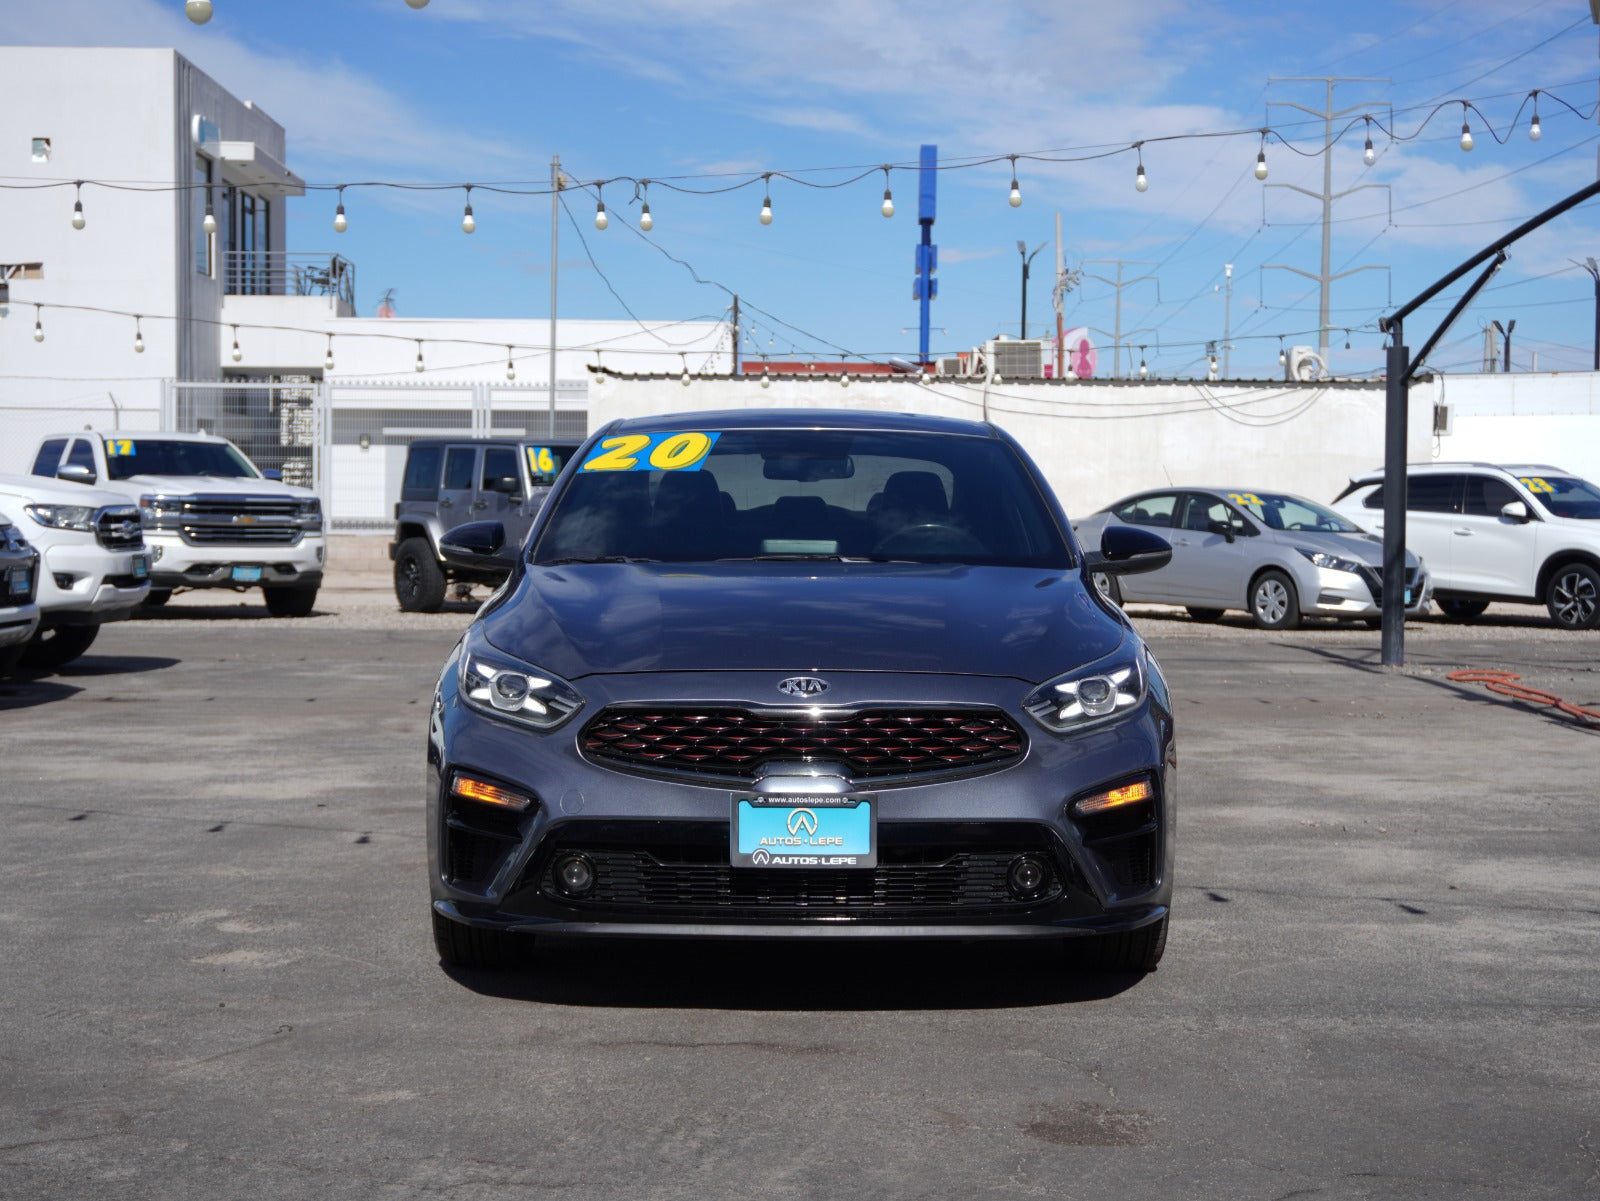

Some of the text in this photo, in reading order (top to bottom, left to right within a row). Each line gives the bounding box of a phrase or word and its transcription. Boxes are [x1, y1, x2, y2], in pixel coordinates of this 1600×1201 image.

[107, 439, 133, 456] 17
[583, 432, 712, 470] 20
[527, 446, 554, 473] 16
[768, 796, 841, 805] www.autoslepe.com
